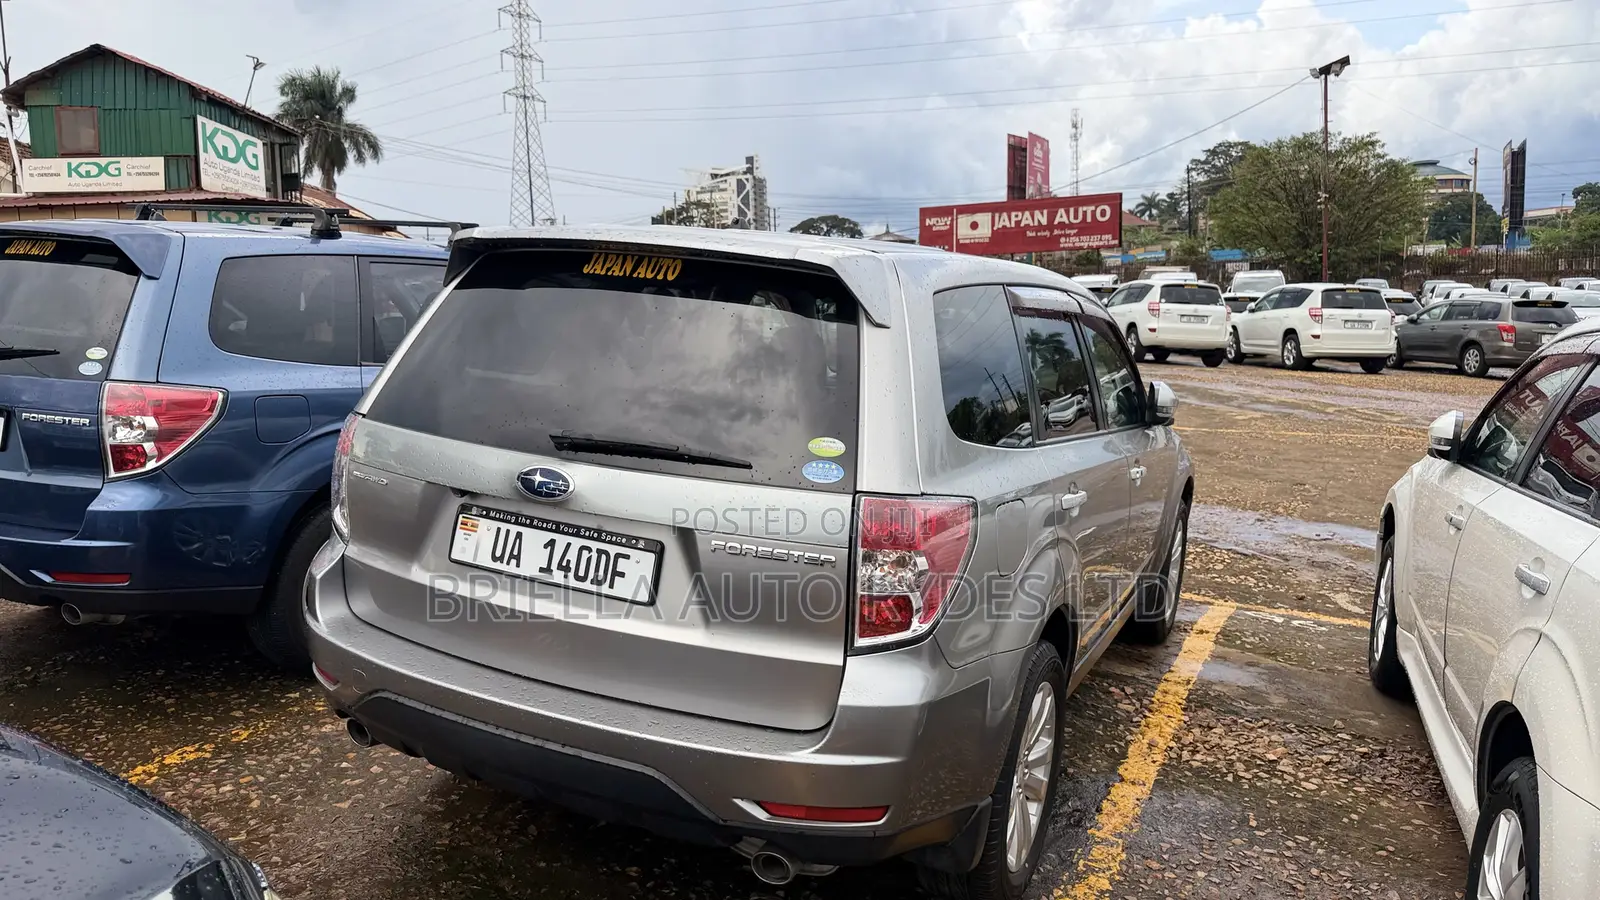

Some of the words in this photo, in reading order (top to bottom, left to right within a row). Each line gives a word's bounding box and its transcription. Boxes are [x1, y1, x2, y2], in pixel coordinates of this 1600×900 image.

[201, 121, 259, 171] KDG
[67, 161, 121, 178] KDG
[219, 162, 240, 177] Uganda
[82, 181, 101, 189] Uganda
[993, 209, 1048, 231] JAPAN
[1053, 204, 1111, 225] AUTO
[5, 240, 37, 255] JAPAN
[28, 240, 56, 256] AUTO
[583, 252, 638, 277] JAPAN
[632, 255, 682, 281] AUTO
[22, 412, 90, 427] FORESTER
[489, 510, 516, 523] Making
[518, 515, 530, 525] the
[532, 518, 557, 530] Roads
[559, 524, 578, 534] Your
[580, 528, 598, 539] Safe
[600, 532, 627, 544] Space
[490, 526, 523, 568] UA
[538, 538, 631, 589] 140DF
[710, 539, 837, 568] FORESTER
